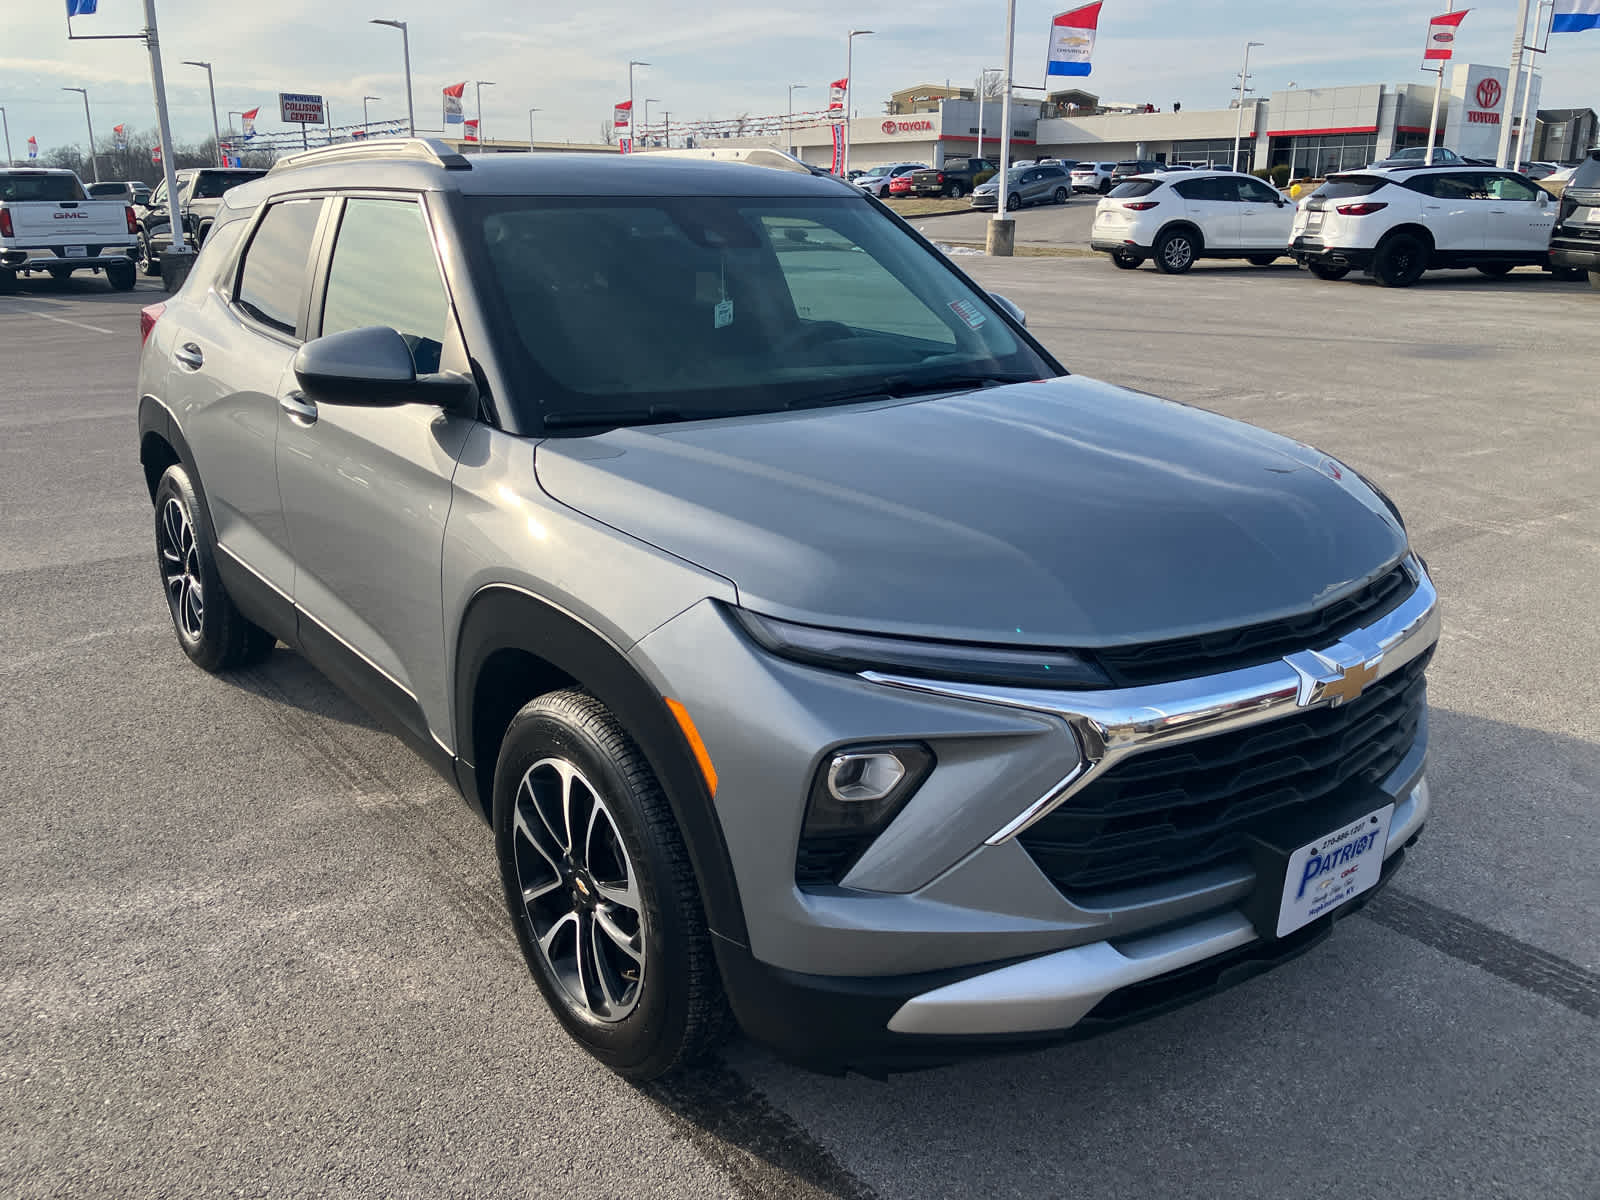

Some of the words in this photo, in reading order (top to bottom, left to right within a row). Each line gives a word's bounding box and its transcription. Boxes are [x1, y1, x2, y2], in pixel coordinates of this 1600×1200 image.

[285, 102, 321, 112] COLLISION
[290, 112, 318, 121] CENTER
[1467, 110, 1500, 124] TOYOTA
[897, 120, 932, 131] TOYOTA
[53, 212, 89, 220] GMC
[1296, 829, 1380, 901] PATRIOT
[1340, 864, 1360, 879] GMC
